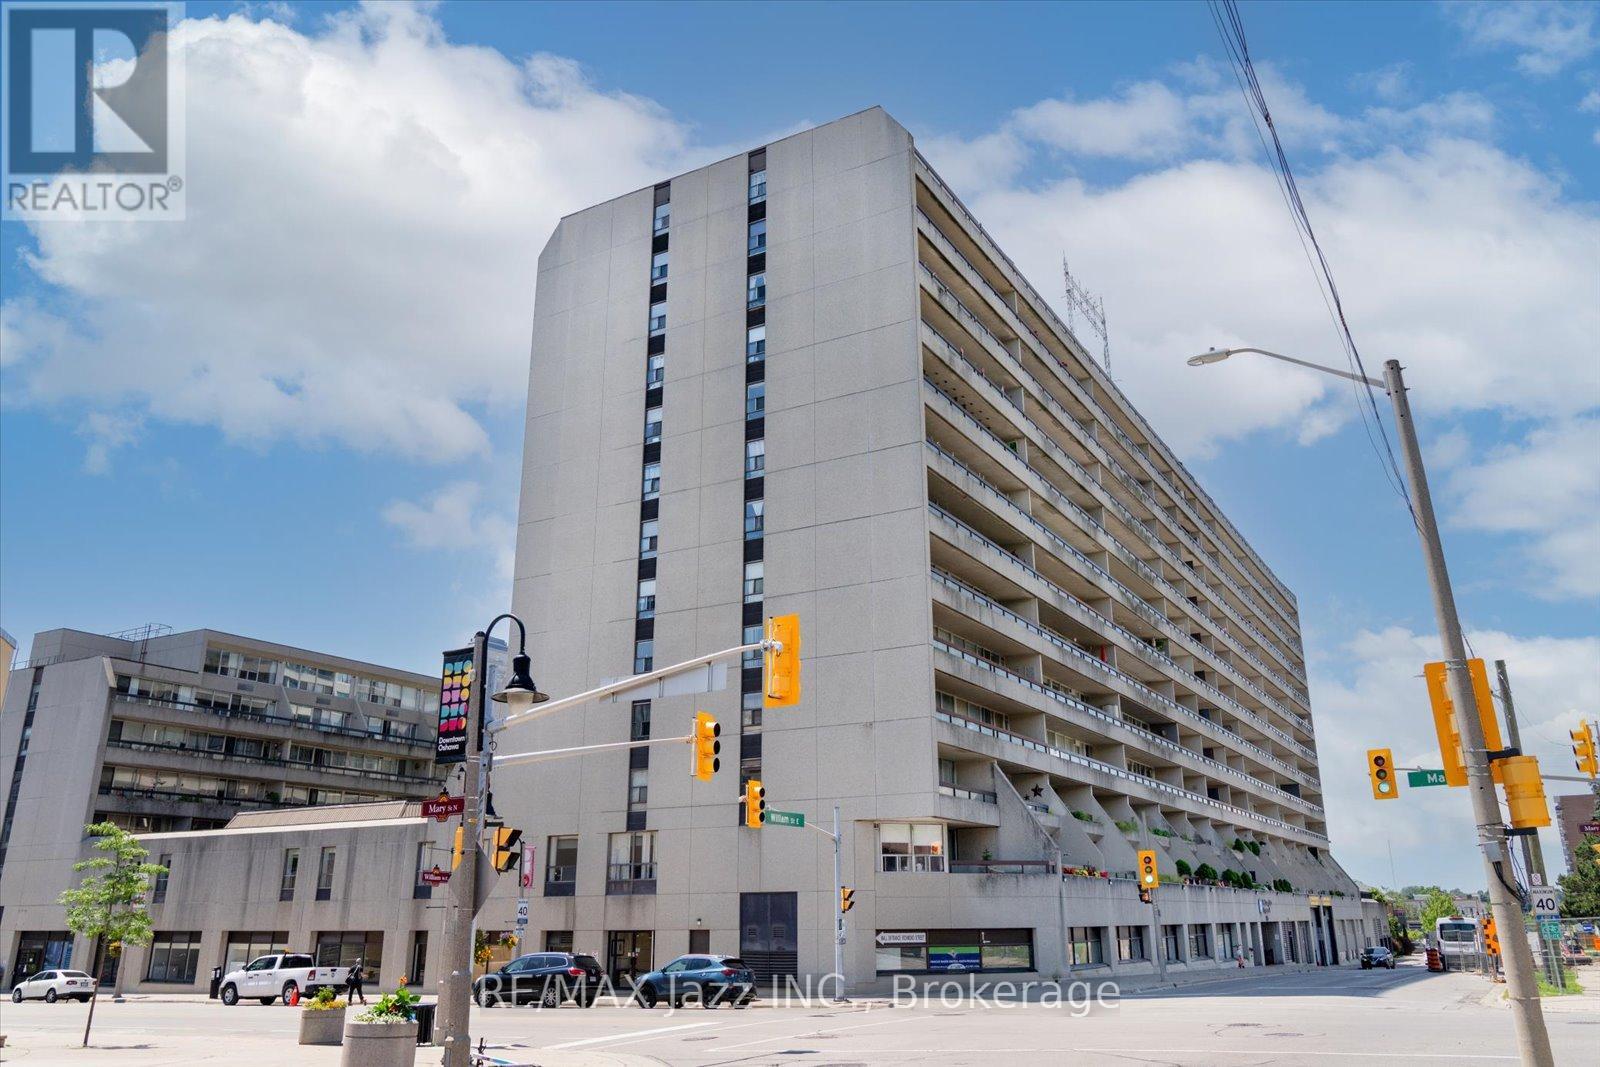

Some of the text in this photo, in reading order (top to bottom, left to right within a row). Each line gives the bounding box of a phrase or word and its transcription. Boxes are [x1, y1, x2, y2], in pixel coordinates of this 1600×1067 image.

[438, 736, 466, 744] Downtown
[429, 803, 446, 813] Mary
[770, 813, 790, 824] William
[1536, 898, 1555, 911] 40
[518, 906, 528, 916] 40
